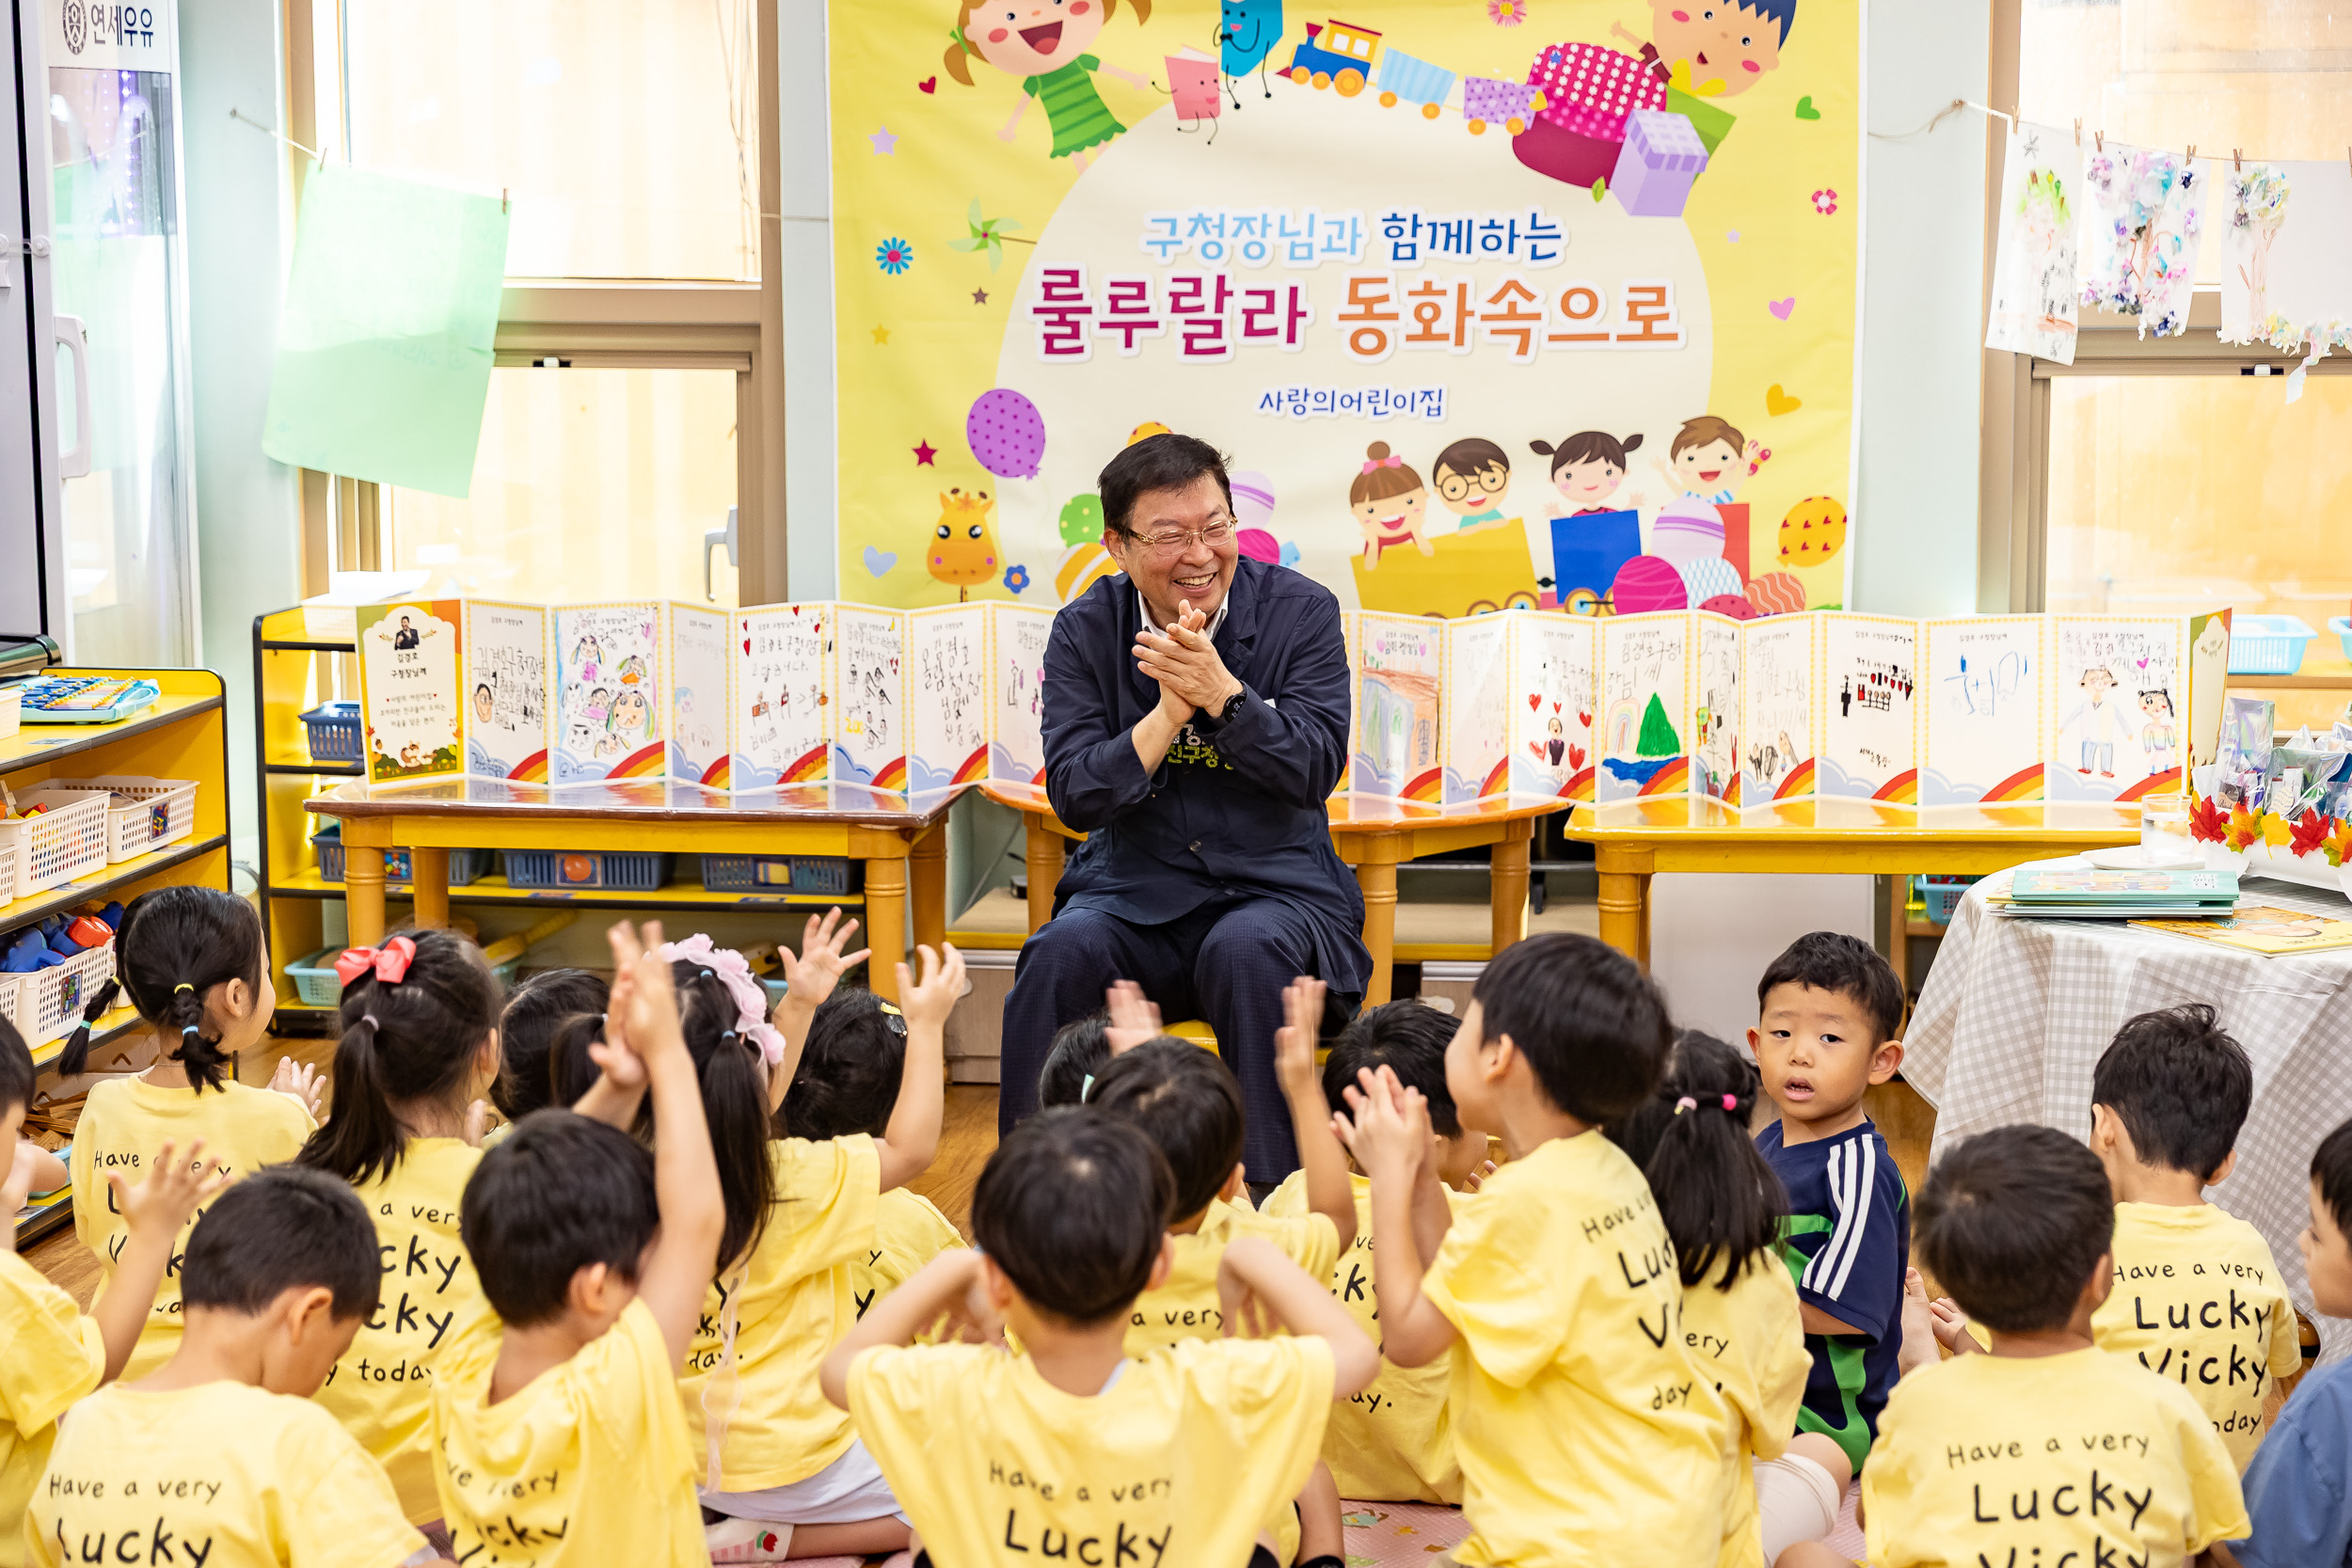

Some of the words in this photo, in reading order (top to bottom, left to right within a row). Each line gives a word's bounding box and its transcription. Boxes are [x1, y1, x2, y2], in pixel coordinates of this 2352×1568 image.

[90, 4, 153, 47] 연세우유
[1146, 213, 1362, 261] 구청장님과
[1381, 213, 1563, 261] 함께하는
[1033, 268, 1307, 356] 룰루랄라
[1337, 277, 1679, 357] 동화속으로
[1258, 388, 1444, 419] 사랑의어린이집
[1167, 745, 1233, 770] 진구청
[94, 1150, 140, 1170] Have
[380, 1203, 393, 1215] a
[1582, 1205, 1636, 1243] Have
[379, 1234, 461, 1294] cky
[2194, 1263, 2206, 1275] a
[2220, 1263, 2264, 1286] very
[1132, 1313, 1146, 1326] a
[2135, 1289, 2271, 1343] Lucky
[1686, 1333, 1729, 1358] ery
[2138, 1344, 2267, 1398] Vicky
[1652, 1381, 1692, 1410] day
[1947, 1442, 2023, 1469] Have
[2046, 1437, 2061, 1453] a
[2081, 1433, 2149, 1458] very
[50, 1473, 104, 1499] Have
[124, 1481, 138, 1497] a
[158, 1480, 221, 1505] very
[990, 1460, 1055, 1502] Have
[1077, 1486, 1090, 1502] a
[1975, 1469, 2153, 1531] Lucky
[1005, 1507, 1172, 1568] Lucky
